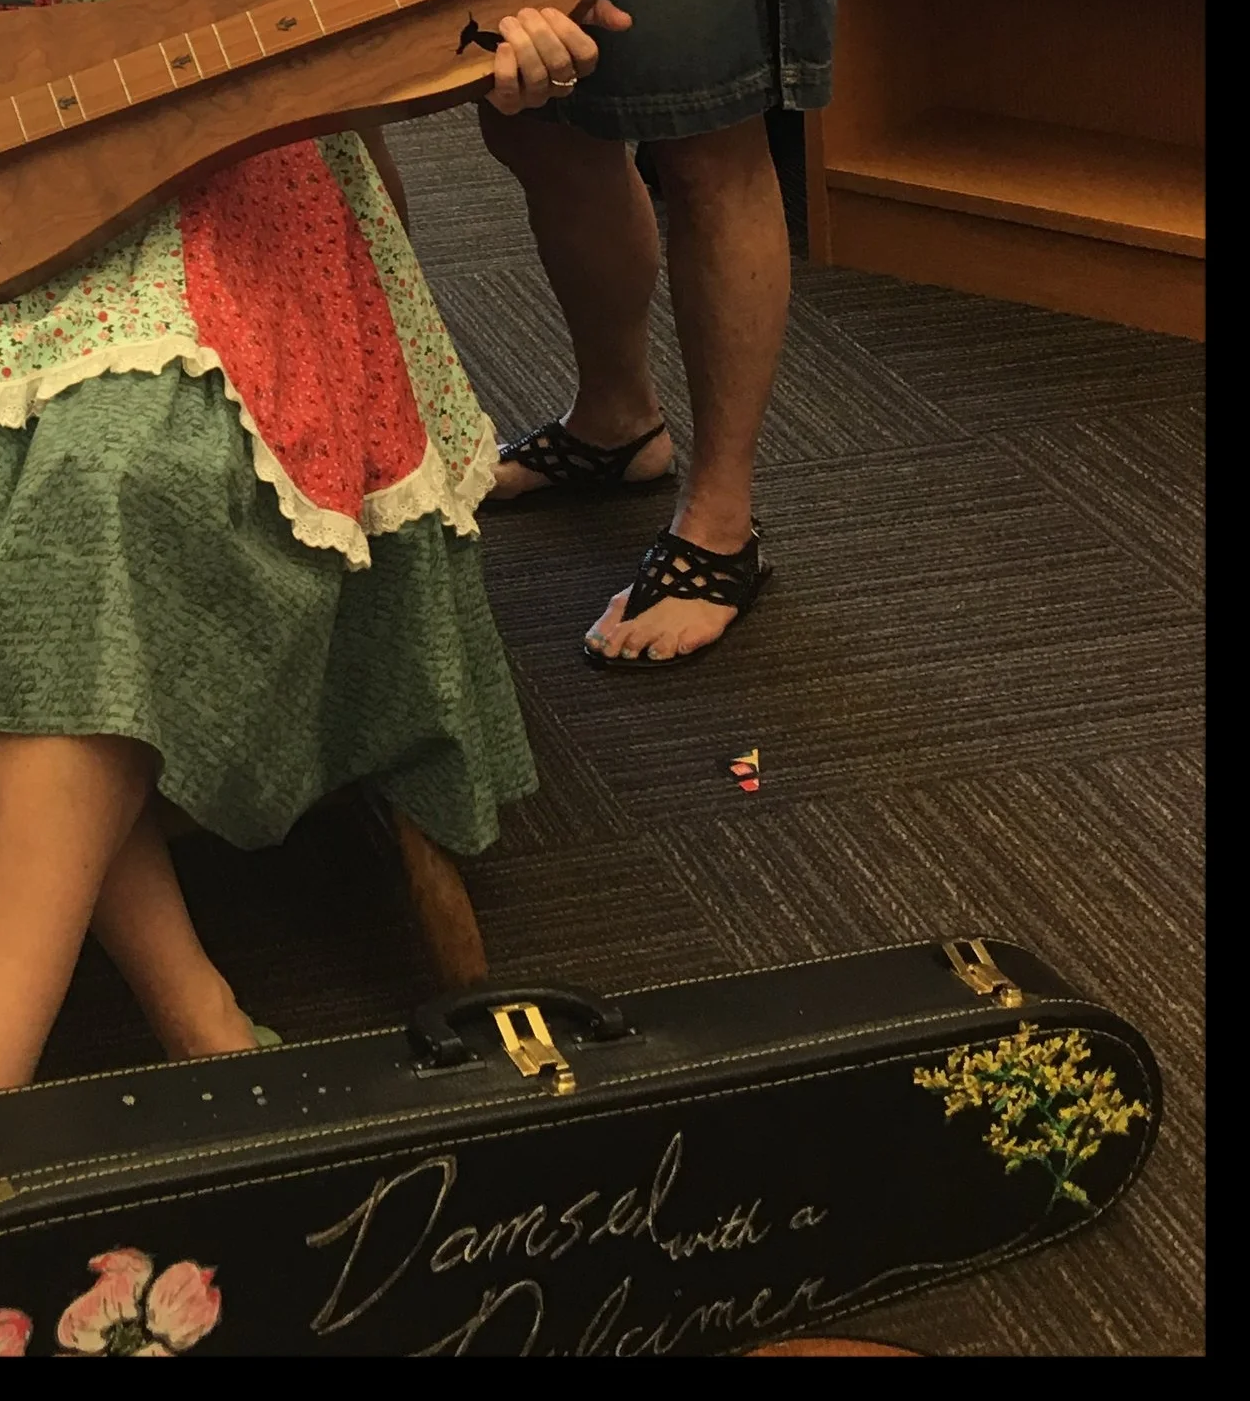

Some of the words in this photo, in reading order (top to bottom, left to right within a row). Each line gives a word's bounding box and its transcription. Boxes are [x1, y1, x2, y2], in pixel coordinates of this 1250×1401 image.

[305, 1130, 683, 1336] Damsel
[661, 1197, 771, 1262] with
[789, 1204, 829, 1231] a
[405, 1275, 835, 1357] lcimer
